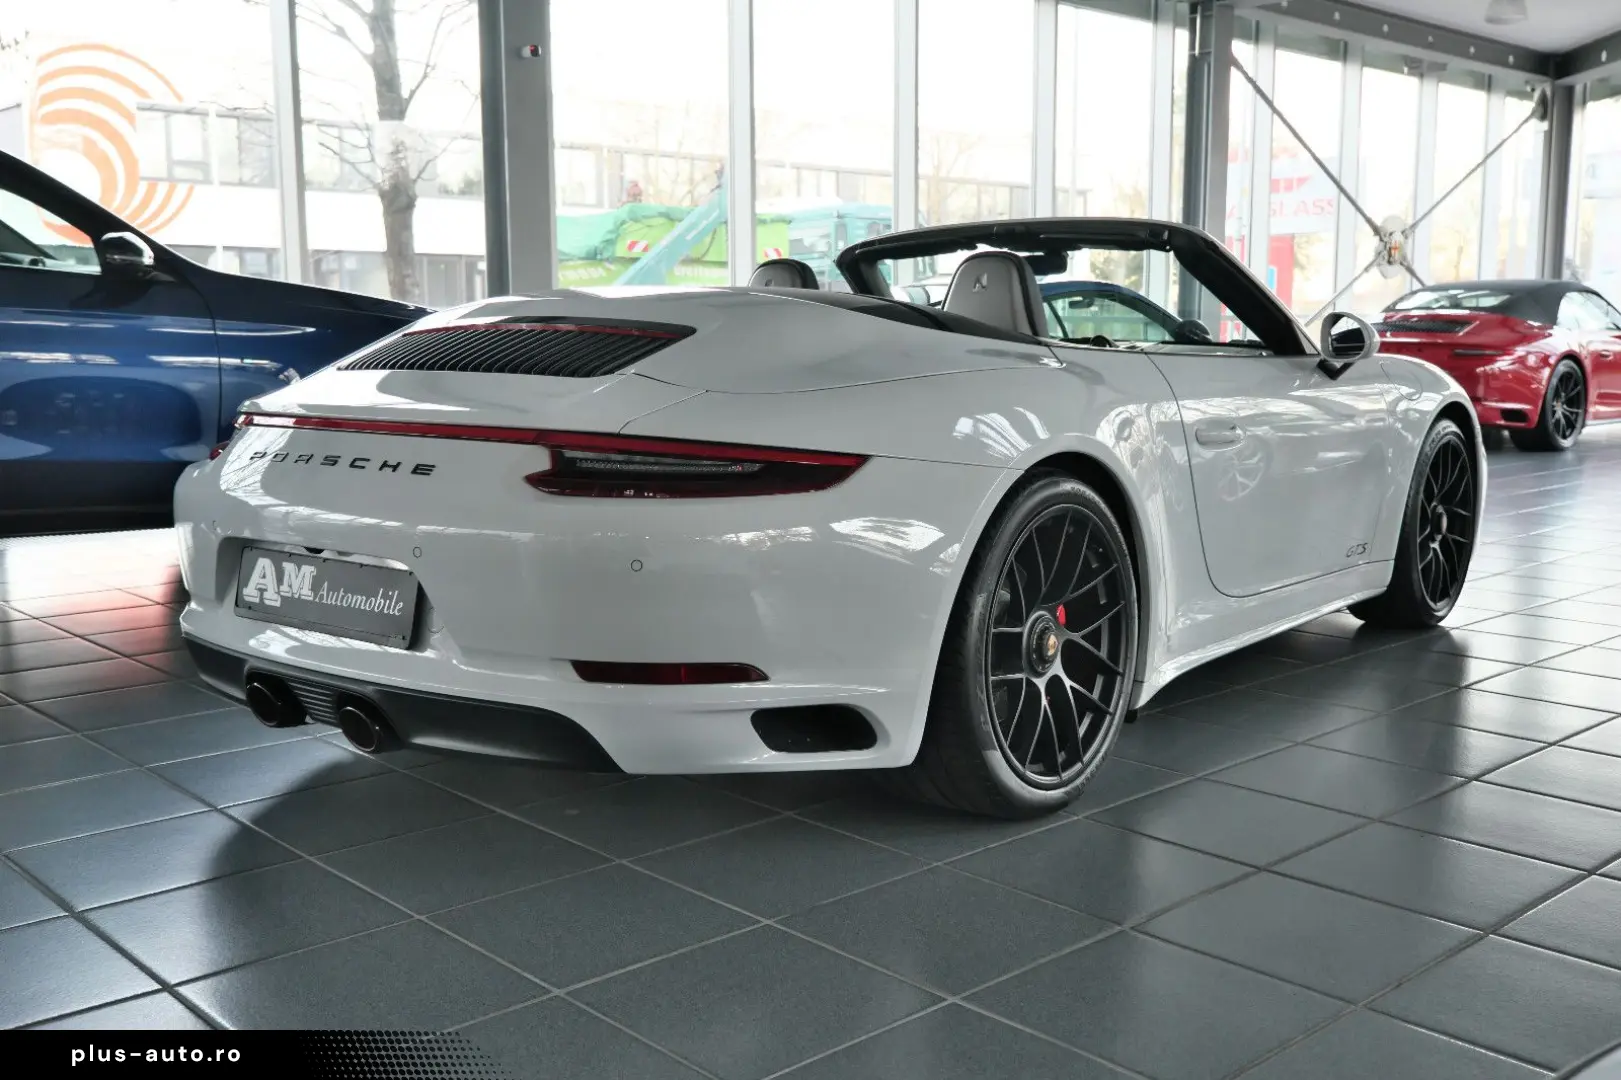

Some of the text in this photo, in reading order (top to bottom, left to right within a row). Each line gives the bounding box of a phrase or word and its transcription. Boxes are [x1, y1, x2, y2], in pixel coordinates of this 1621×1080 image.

[250, 451, 436, 476] PORSCHE
[1346, 542, 1368, 558] GTS
[243, 557, 404, 616] AM Automobile
